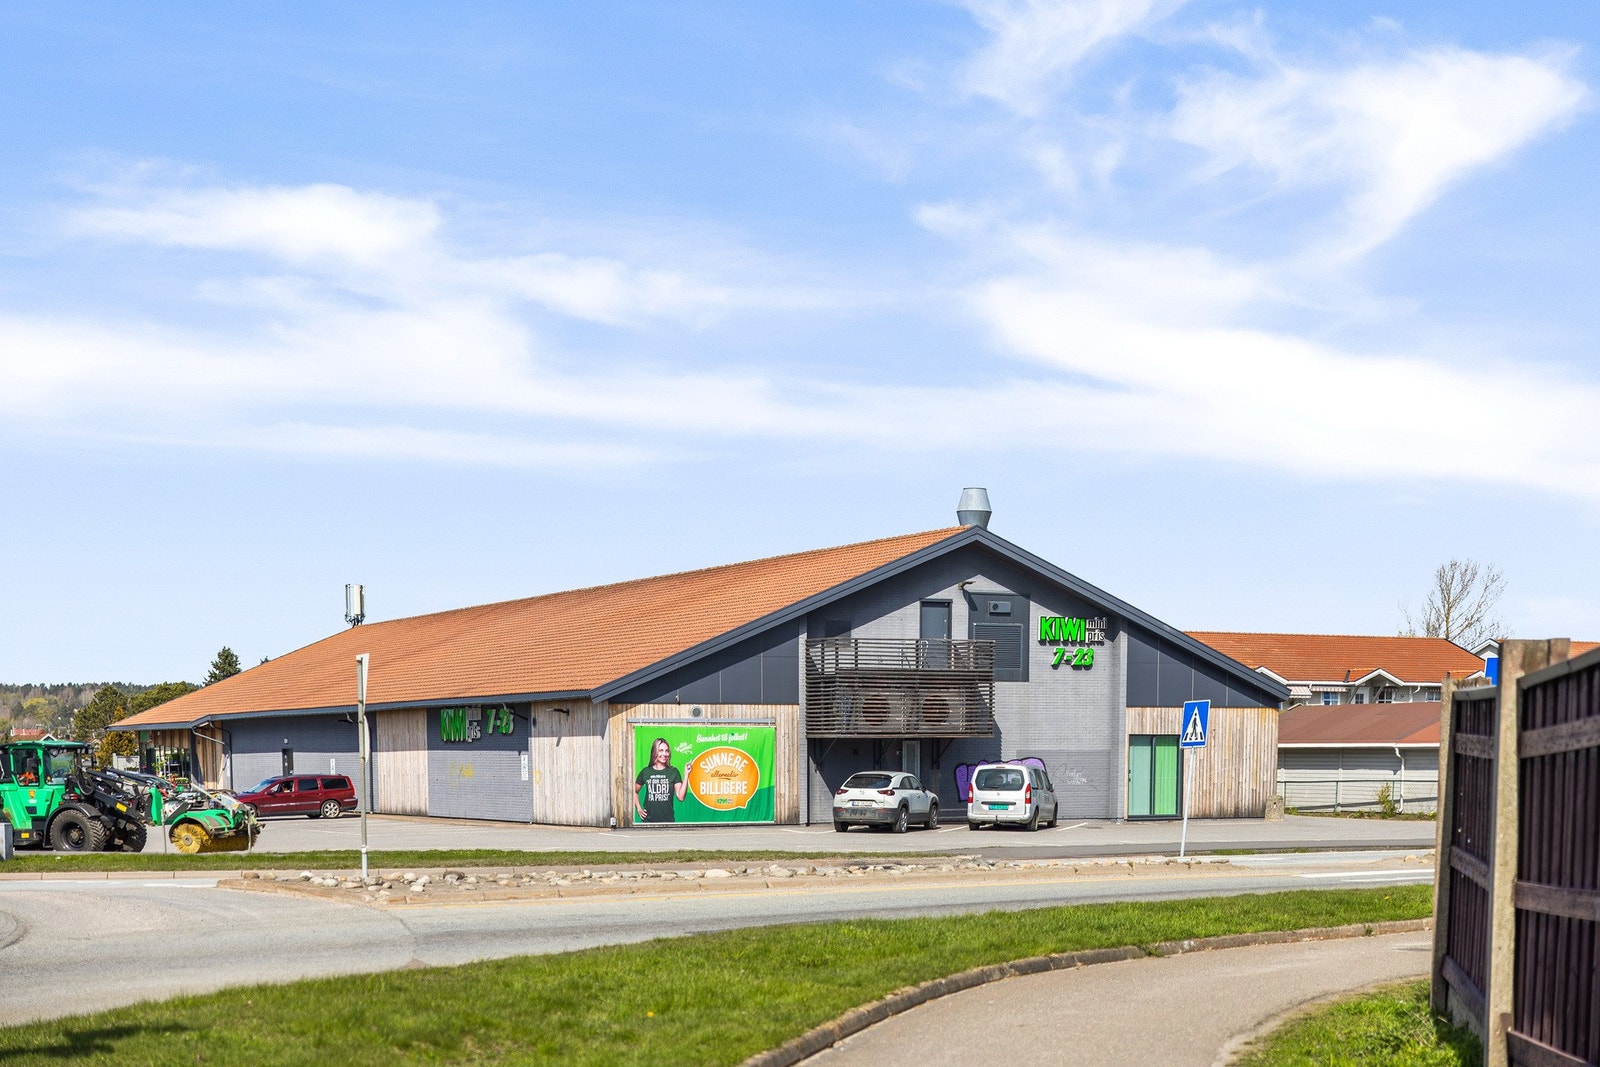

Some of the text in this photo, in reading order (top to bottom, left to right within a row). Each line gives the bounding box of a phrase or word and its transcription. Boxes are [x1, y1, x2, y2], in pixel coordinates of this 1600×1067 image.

[1038, 616, 1107, 642] KIWI mini
[1085, 629, 1105, 643] pris
[1051, 647, 1095, 666] 7-23
[700, 752, 749, 773] SUNNERE
[648, 783, 670, 794] ALDRI
[700, 781, 748, 795] BILLIGERE
